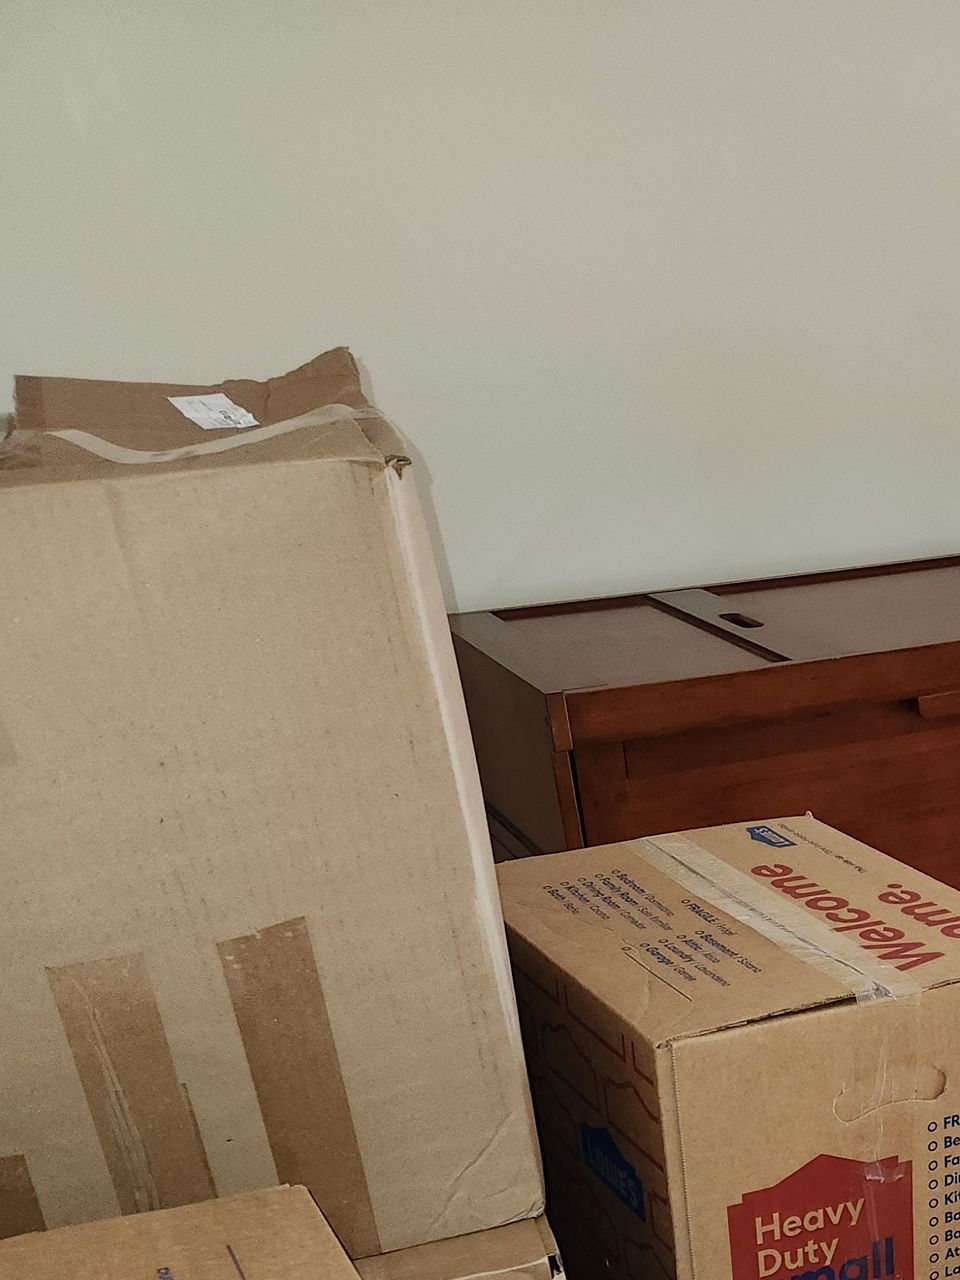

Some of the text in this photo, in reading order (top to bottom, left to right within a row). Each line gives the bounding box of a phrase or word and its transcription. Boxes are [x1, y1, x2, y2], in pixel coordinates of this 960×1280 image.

[687, 902, 719, 924] FRAGILE
[751, 864, 945, 972] Welcome
[700, 933, 739, 958] Basement
[755, 1198, 864, 1245] Heavy
[757, 1237, 840, 1278] Duty
